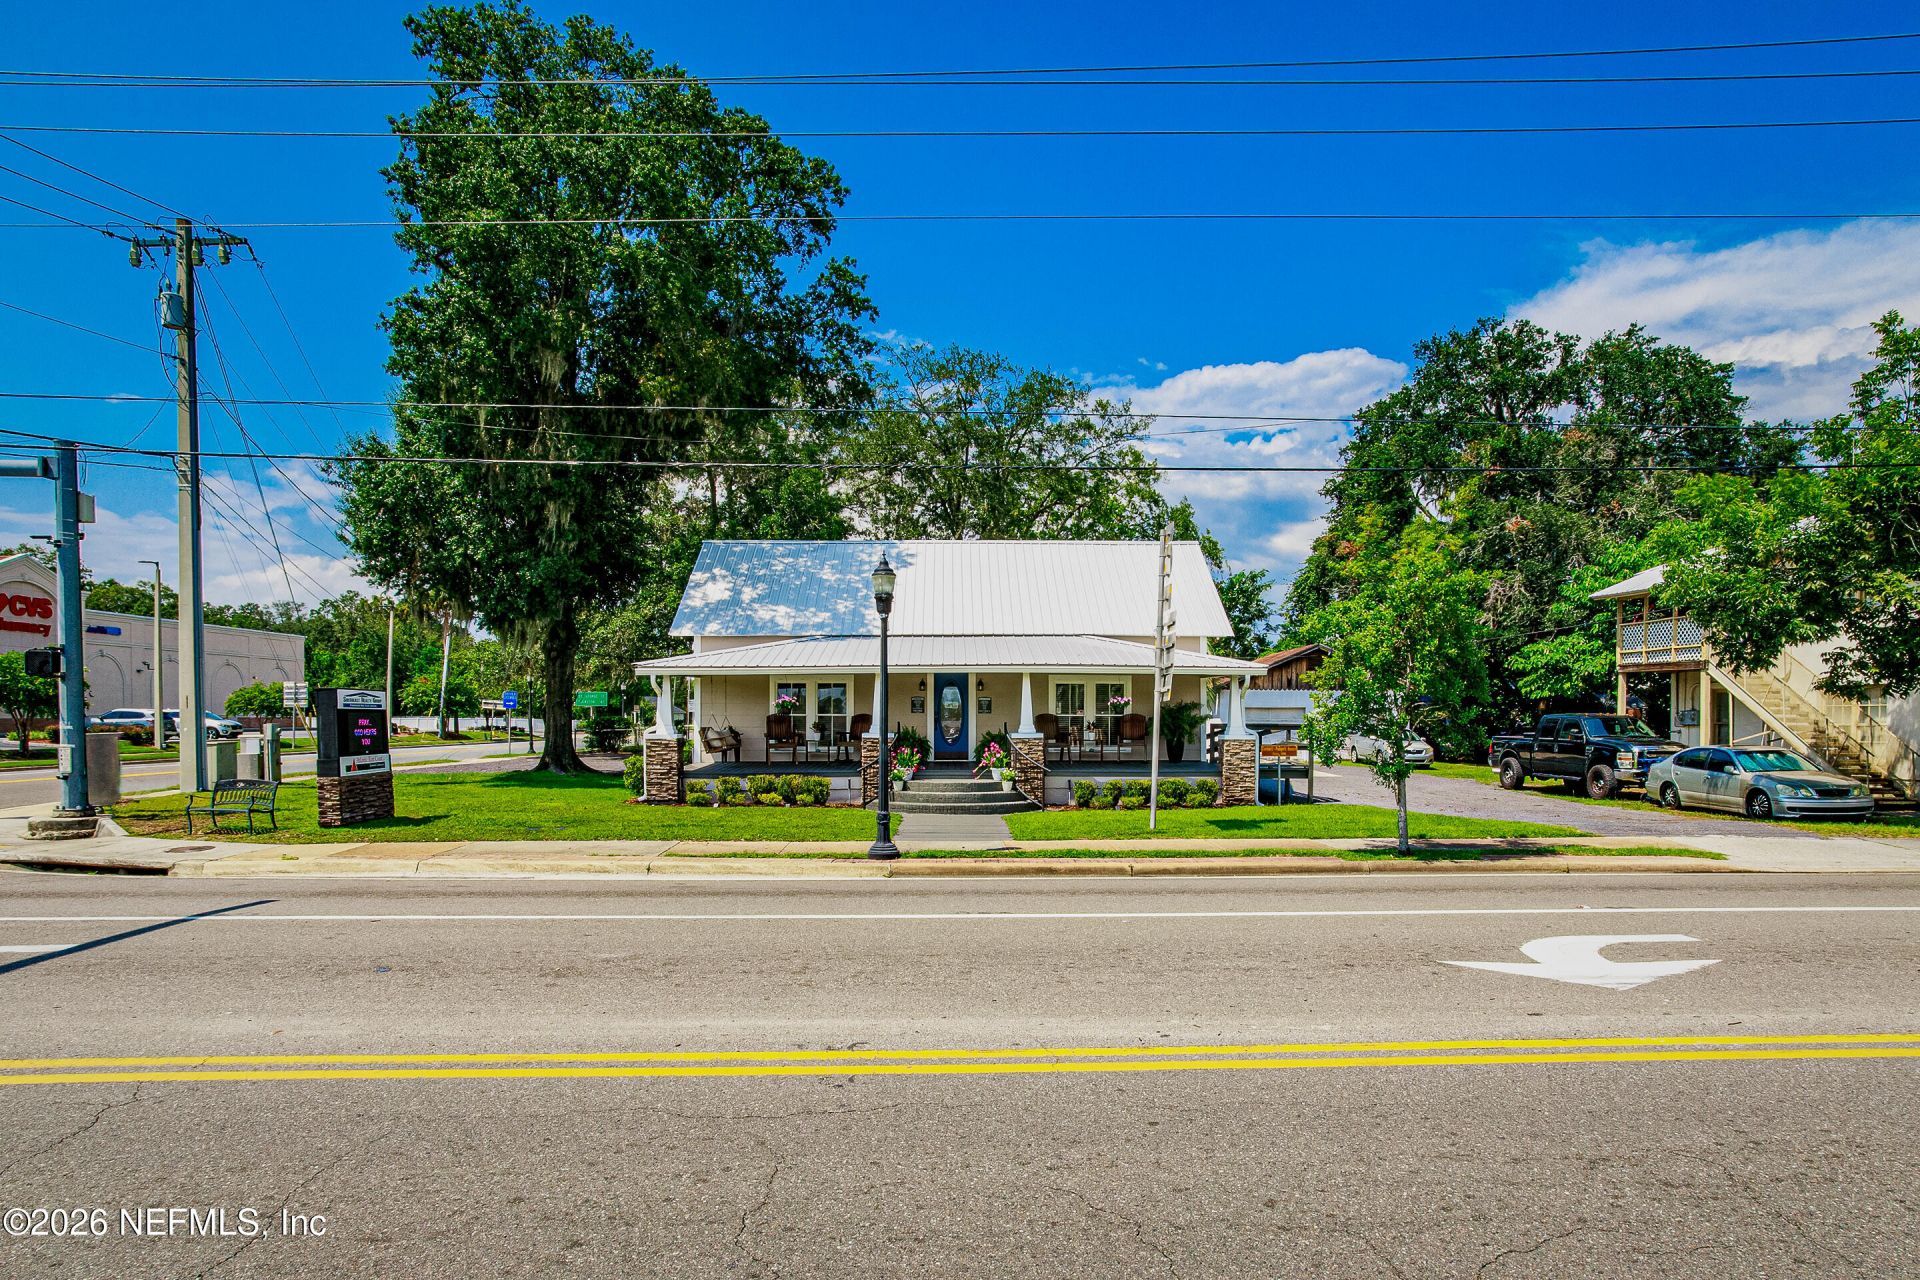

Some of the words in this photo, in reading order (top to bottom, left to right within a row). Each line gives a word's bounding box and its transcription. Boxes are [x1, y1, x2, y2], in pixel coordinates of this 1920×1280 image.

[9, 594, 53, 619] CVS
[0, 616, 52, 637] harmacy
[361, 738, 371, 746] YOU
